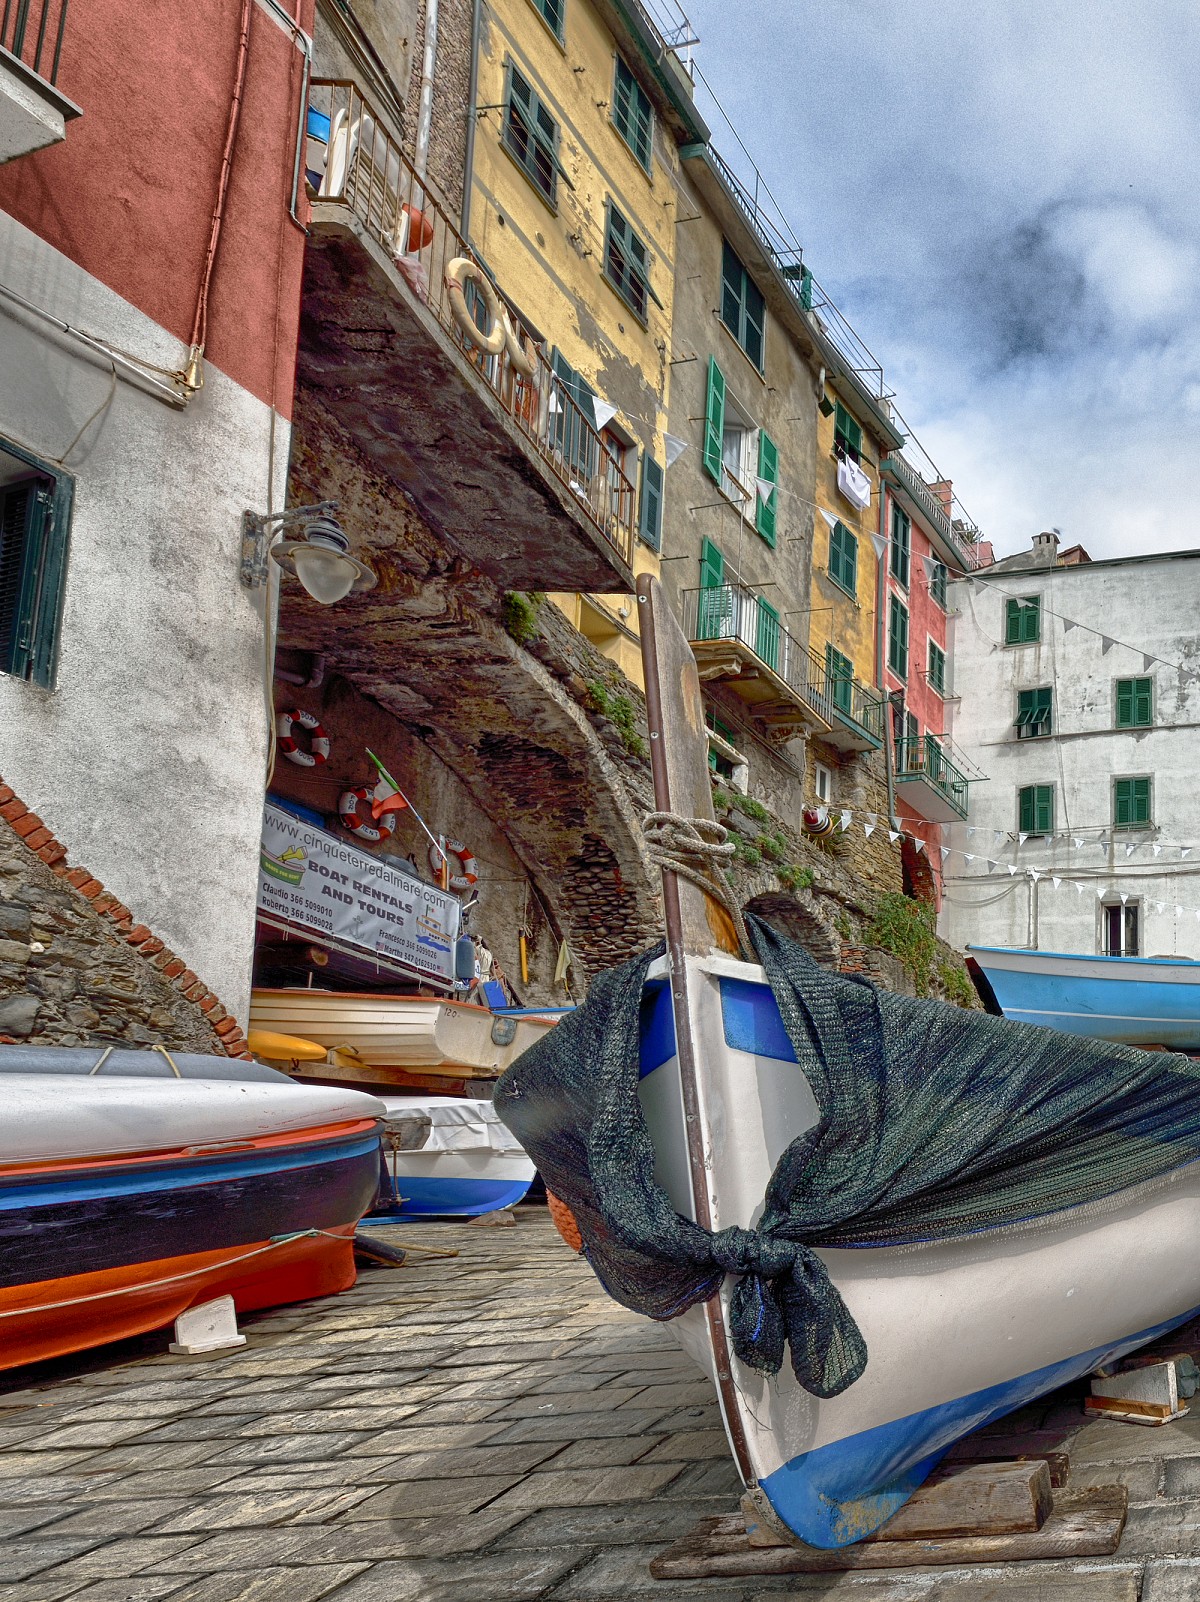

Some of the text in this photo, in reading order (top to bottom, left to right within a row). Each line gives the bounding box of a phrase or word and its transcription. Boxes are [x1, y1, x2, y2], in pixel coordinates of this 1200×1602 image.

[300, 711, 319, 725] BOAT
[296, 749, 315, 763] TOURS
[360, 824, 379, 837] RENT
[264, 813, 446, 909] www.cinqueterredalmare.com
[262, 882, 333, 917] Claudio 366 5099010
[308, 860, 413, 914] BOAT RENTALS
[262, 896, 333, 931] Roberto 366 5099028
[321, 885, 404, 926] AND TOURS
[379, 929, 405, 946] Francesco
